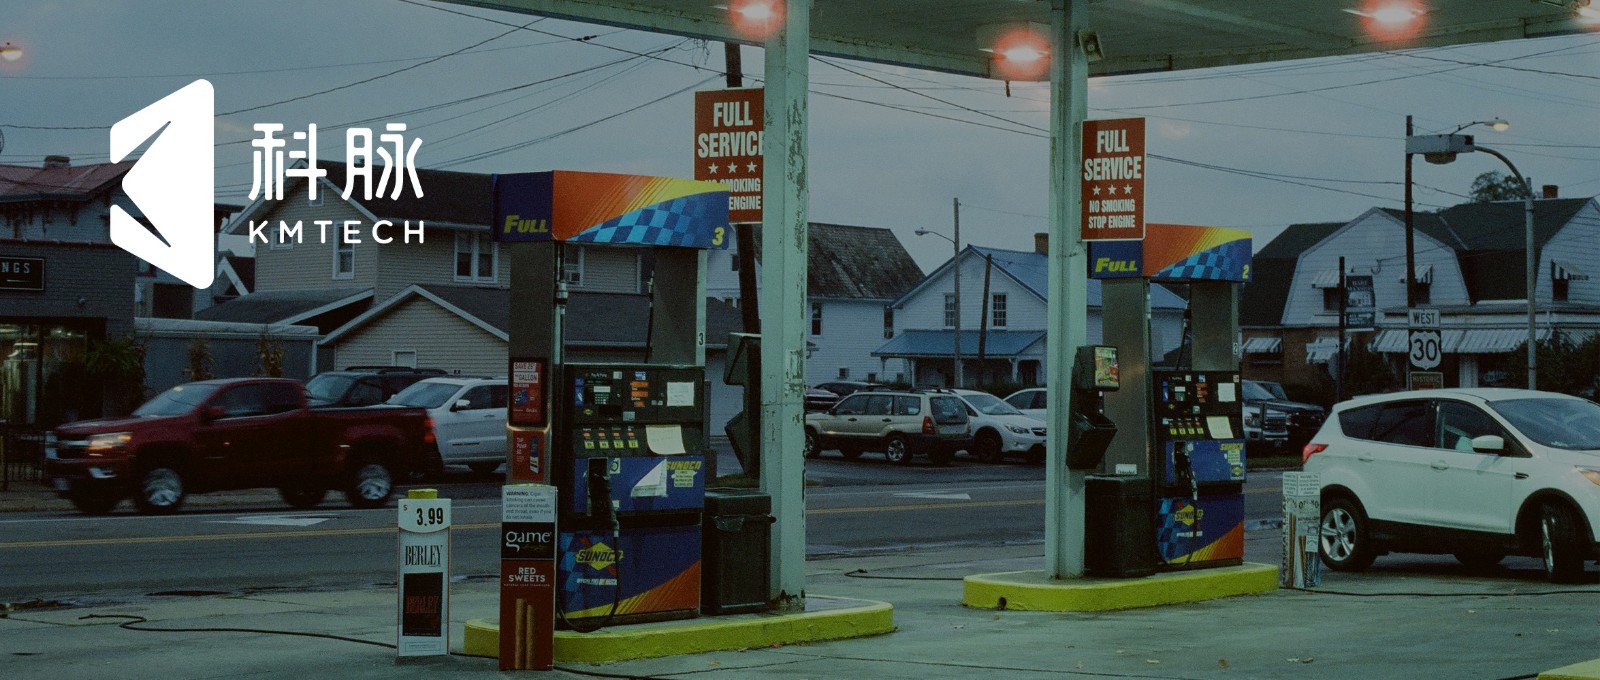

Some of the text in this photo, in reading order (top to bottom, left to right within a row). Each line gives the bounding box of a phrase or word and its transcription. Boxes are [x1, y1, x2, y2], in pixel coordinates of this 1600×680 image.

[713, 101, 753, 127] FULL
[1096, 129, 1130, 153] FULL
[1084, 156, 1142, 181] SERVICE
[729, 195, 761, 211] ENGINE
[1089, 198, 1136, 213] NO SMOKING
[504, 214, 549, 234] FULL
[1088, 214, 1136, 229] STOP ENGINE
[712, 227, 725, 246] 3
[1095, 257, 1138, 273] FULL
[1242, 264, 1250, 279] 2
[1412, 312, 1436, 325] WEST
[698, 332, 704, 345] 3
[1412, 338, 1438, 361] 30
[416, 507, 444, 526] 3.99
[405, 545, 442, 566] BERLEY
[508, 574, 546, 583] SWEETS
[518, 567, 537, 575] RED
